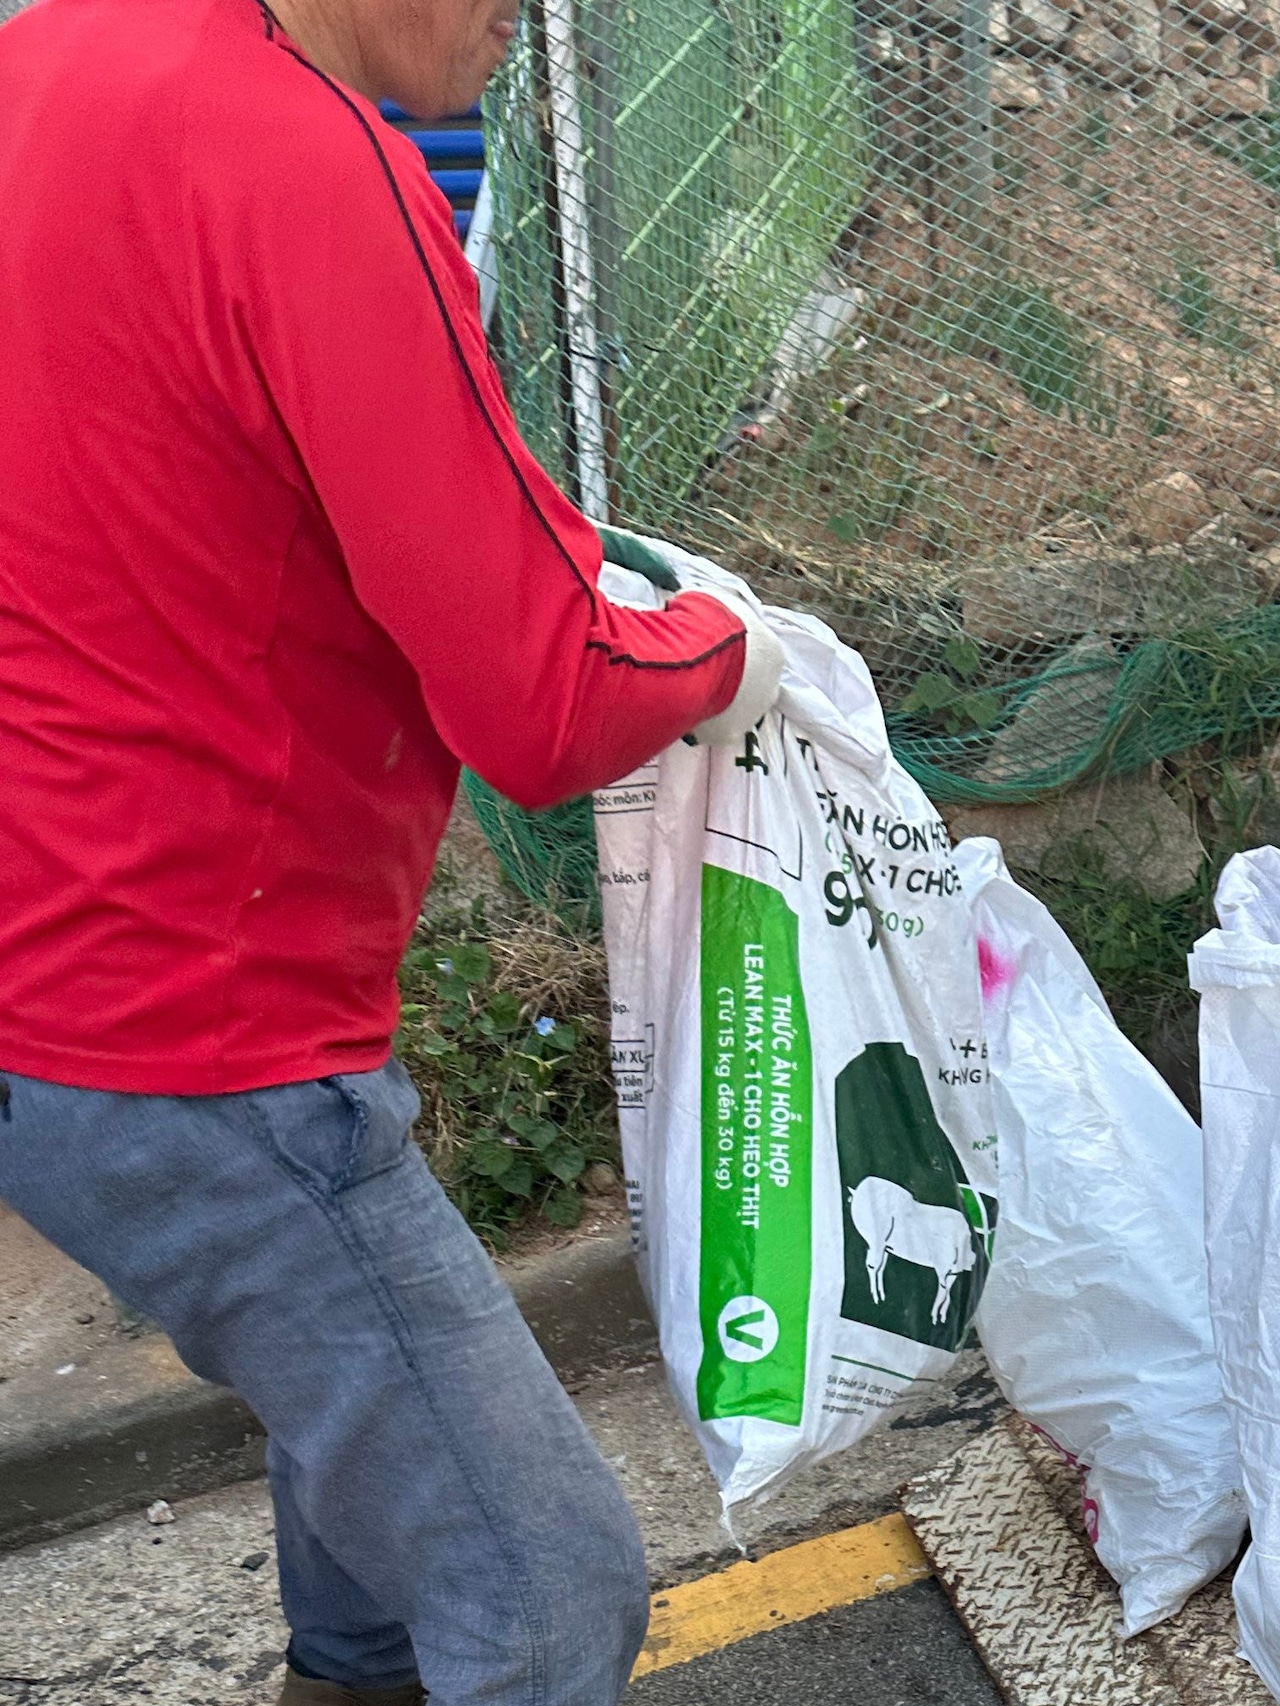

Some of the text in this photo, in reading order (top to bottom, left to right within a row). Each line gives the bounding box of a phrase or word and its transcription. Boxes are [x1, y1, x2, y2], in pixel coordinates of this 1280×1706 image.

[744, 943, 764, 1000] LEAN
[743, 1006, 764, 1054] MAX
[715, 986, 739, 1190] (Từ 15 kg đến 30 kg)
[744, 1072, 763, 1080] 1
[763, 994, 802, 1188] THỨC ĂN HỖN HỢP
[743, 1083, 762, 1130] CHO
[742, 1135, 761, 1178] HEO
[736, 1184, 760, 1230] THỊT
